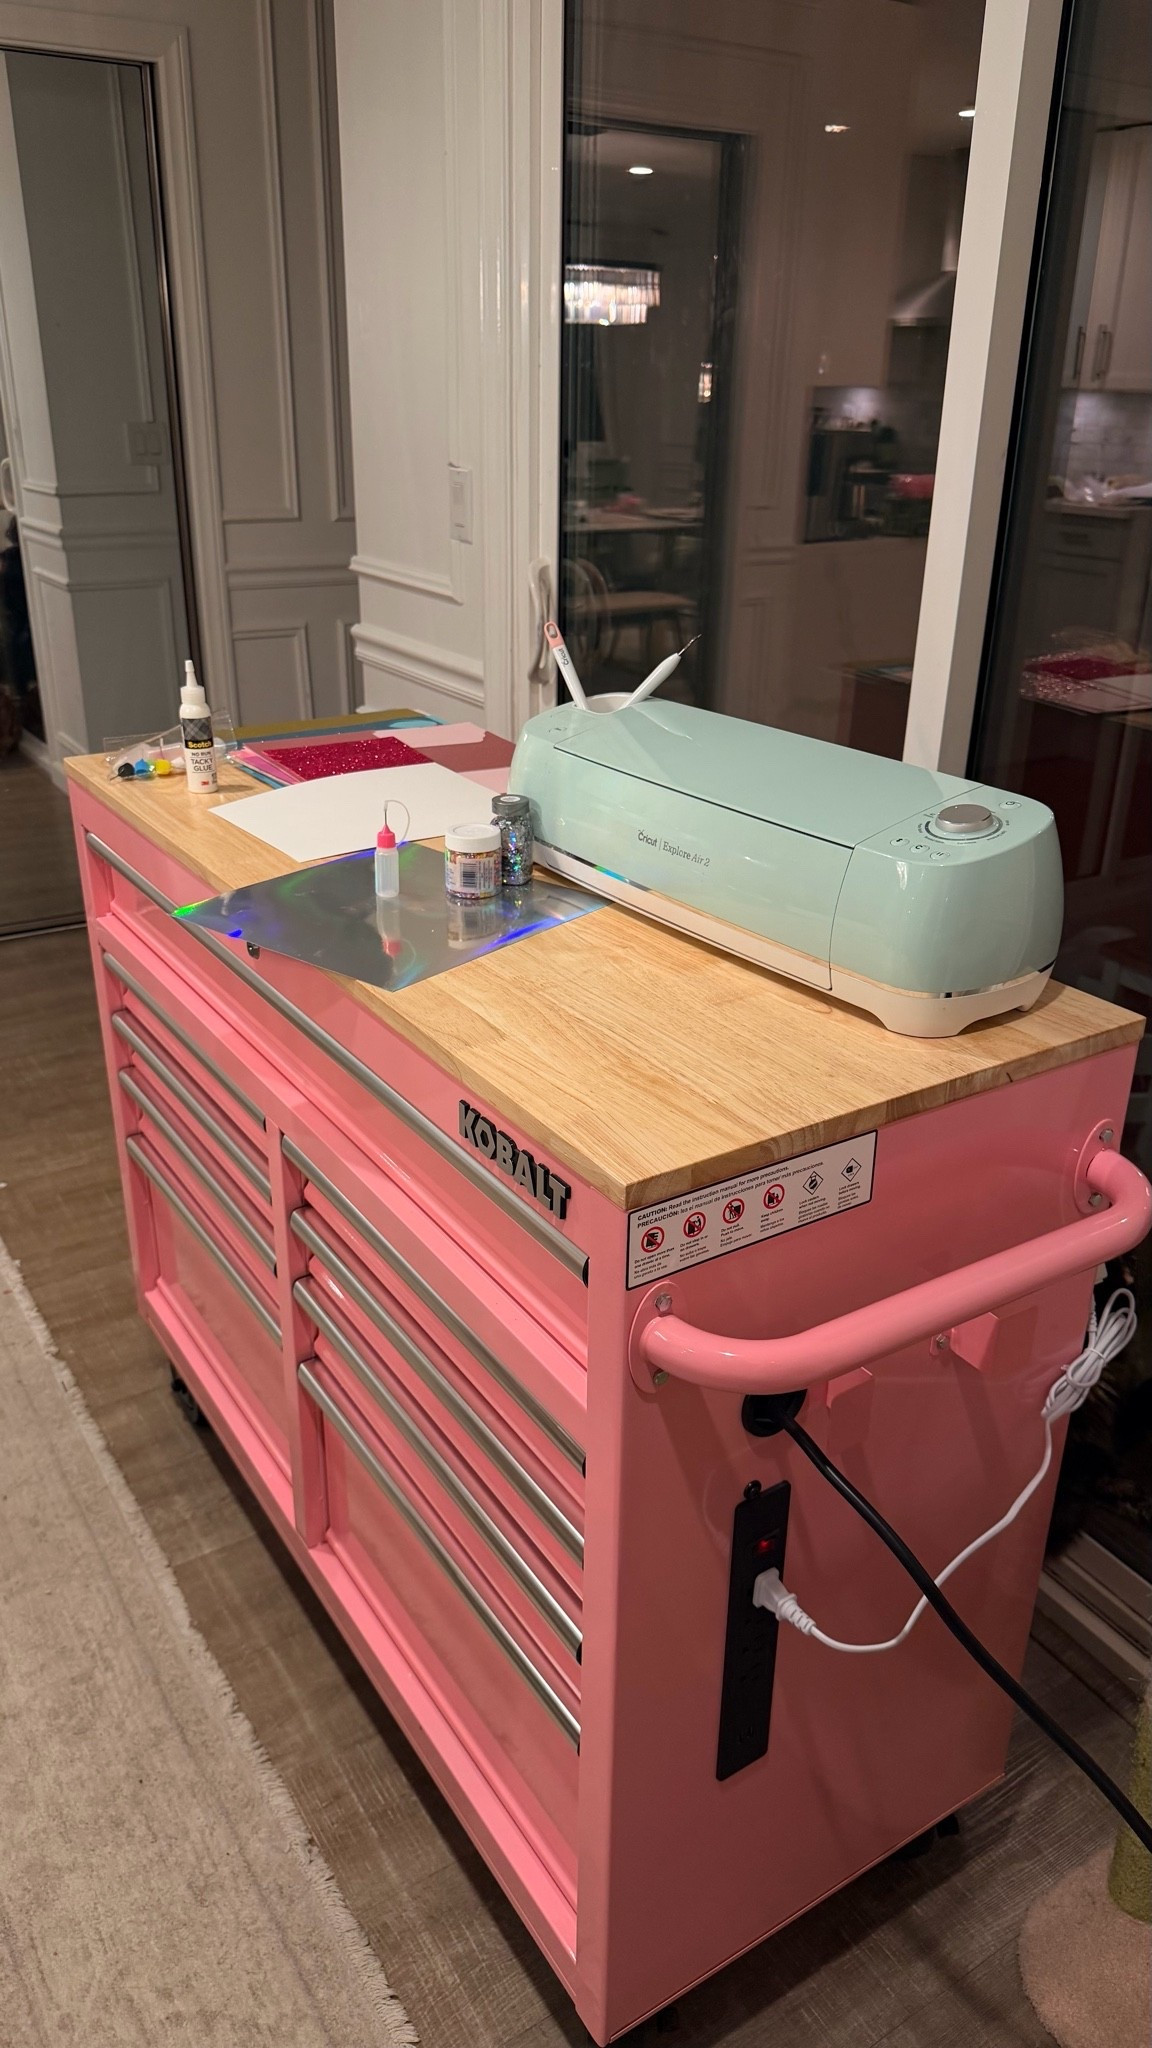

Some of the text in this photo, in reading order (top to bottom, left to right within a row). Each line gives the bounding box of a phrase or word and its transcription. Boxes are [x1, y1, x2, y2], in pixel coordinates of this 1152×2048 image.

[194, 764, 212, 772] GLUE
[638, 829, 710, 868] Cricut Explore Air 2
[458, 1099, 572, 1220] KOBALT
[637, 1210, 679, 1228] PRECAUCIÓN:
[694, 1198, 713, 1208] manual
[721, 1186, 754, 1200] instrucciones
[754, 1181, 766, 1189] para
[638, 1207, 668, 1220] CAUTION:
[668, 1202, 682, 1210] Read
[682, 1198, 691, 1206] the
[692, 1189, 719, 1202] instruction
[720, 1182, 738, 1192] manual
[747, 1176, 759, 1184] more
[760, 1166, 789, 1180] precautions.
